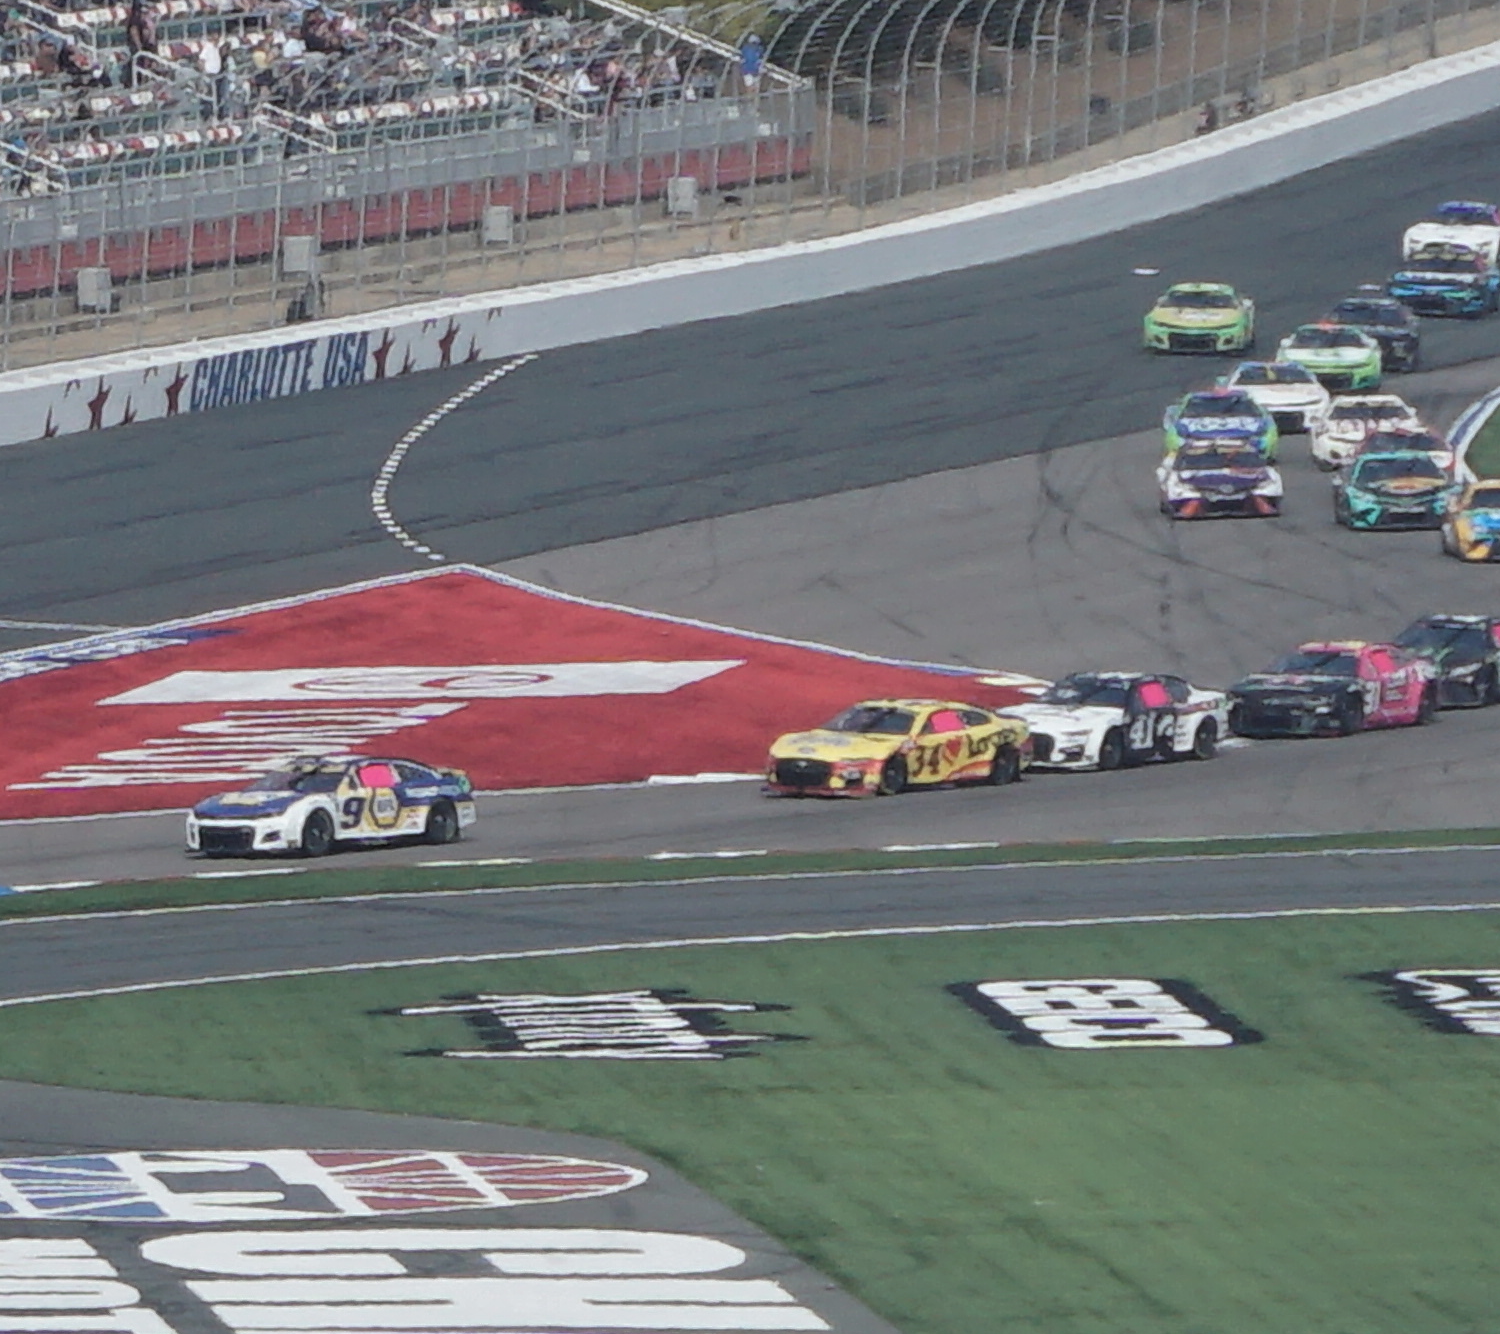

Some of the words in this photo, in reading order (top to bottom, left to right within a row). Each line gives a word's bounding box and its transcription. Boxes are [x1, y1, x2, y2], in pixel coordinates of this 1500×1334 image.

[190, 338, 318, 412] CHARLOTTE
[322, 331, 370, 388] USA
[6, 702, 469, 790] TOYOTA
[341, 797, 365, 829] 9
[976, 978, 1234, 1049] GEICO
